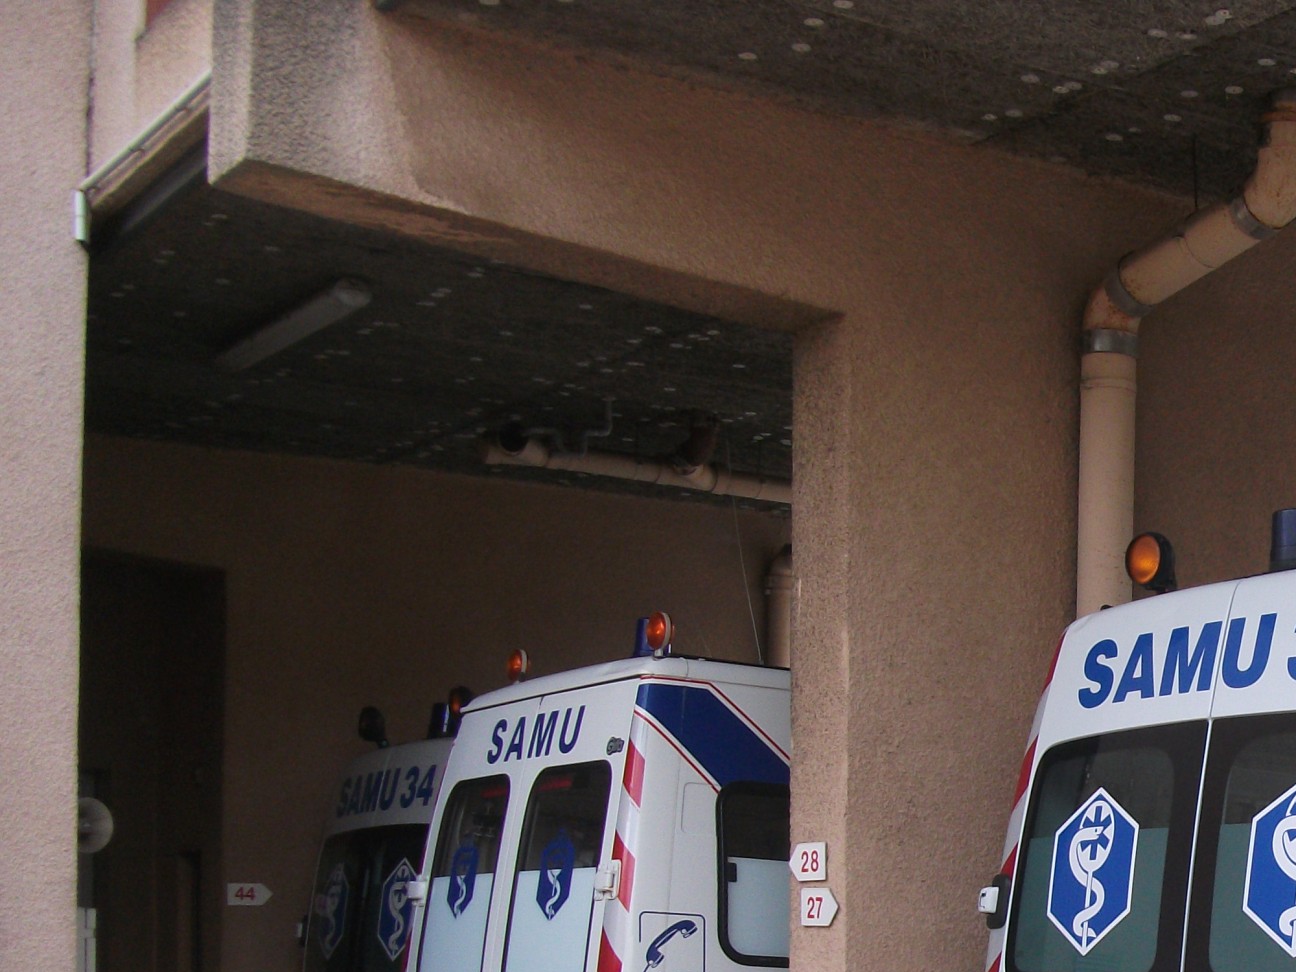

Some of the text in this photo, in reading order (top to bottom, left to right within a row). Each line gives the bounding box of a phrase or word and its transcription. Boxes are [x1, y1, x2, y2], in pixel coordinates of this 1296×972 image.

[1077, 612, 1278, 709] SAMU
[486, 704, 586, 765] SAMU
[336, 764, 437, 818] SAMU 34
[801, 850, 819, 873] 28
[235, 886, 256, 901] 44
[807, 896, 823, 919] 27
